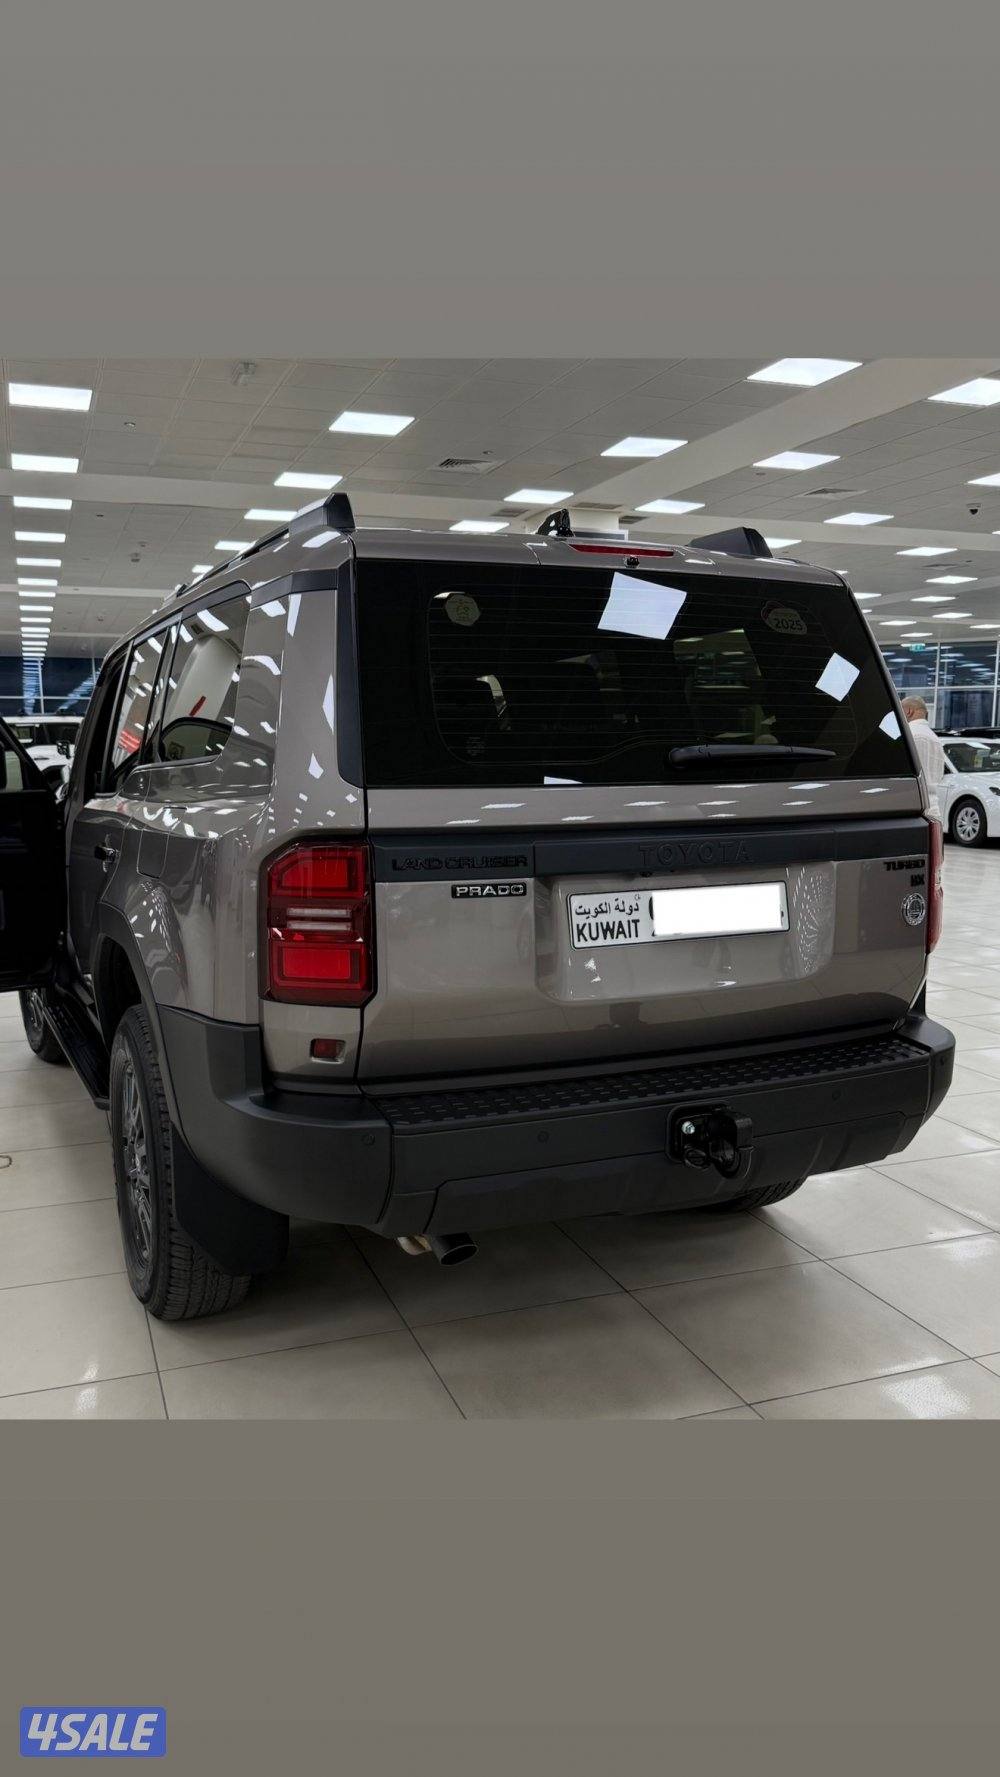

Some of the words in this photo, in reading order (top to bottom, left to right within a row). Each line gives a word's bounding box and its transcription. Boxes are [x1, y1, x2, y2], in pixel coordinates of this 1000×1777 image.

[774, 618, 803, 630] 2025
[392, 857, 443, 871] LAND
[445, 854, 528, 869] CRUISER
[638, 840, 754, 867] TOYOTA
[455, 884, 525, 897] PRADO
[575, 901, 611, 920] الكويت
[614, 898, 640, 916] دولة
[576, 919, 640, 943] KUWAIT
